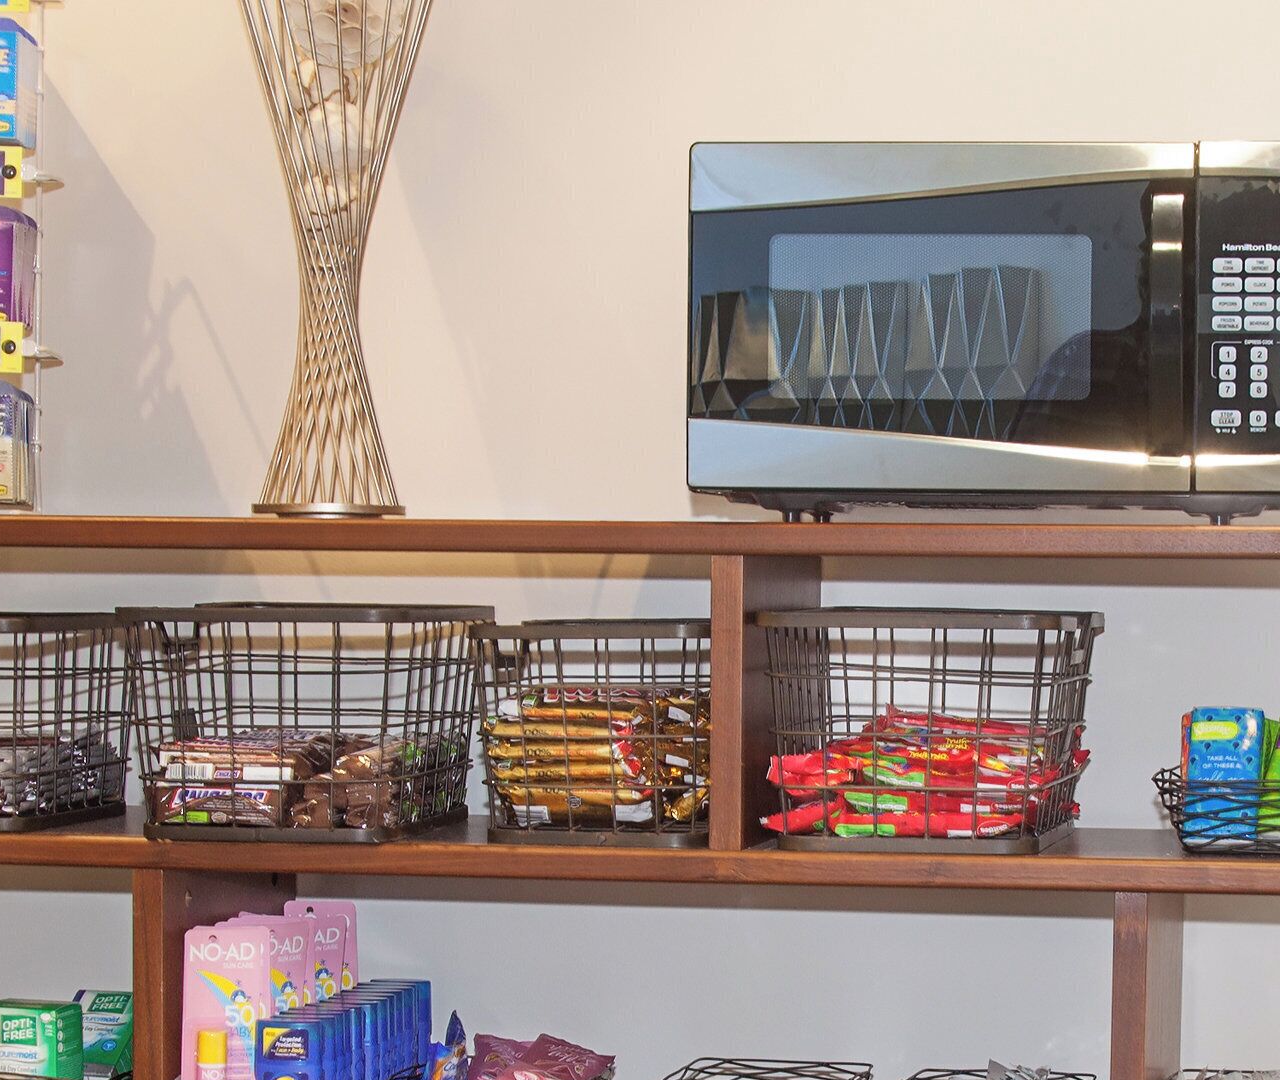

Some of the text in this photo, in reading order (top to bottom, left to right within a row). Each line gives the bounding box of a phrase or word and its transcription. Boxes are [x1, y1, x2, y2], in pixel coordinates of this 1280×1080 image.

[1222, 243, 1265, 251] Hamilton
[190, 942, 255, 962] NO-AD
[95, 995, 127, 1003] OPTI-
[225, 1005, 255, 1026] 50
[2, 1018, 33, 1031] OPTI-
[3, 1029, 34, 1041] FREE
[0, 1050, 37, 1062] puremoist
[7, 1065, 16, 1073] Day
